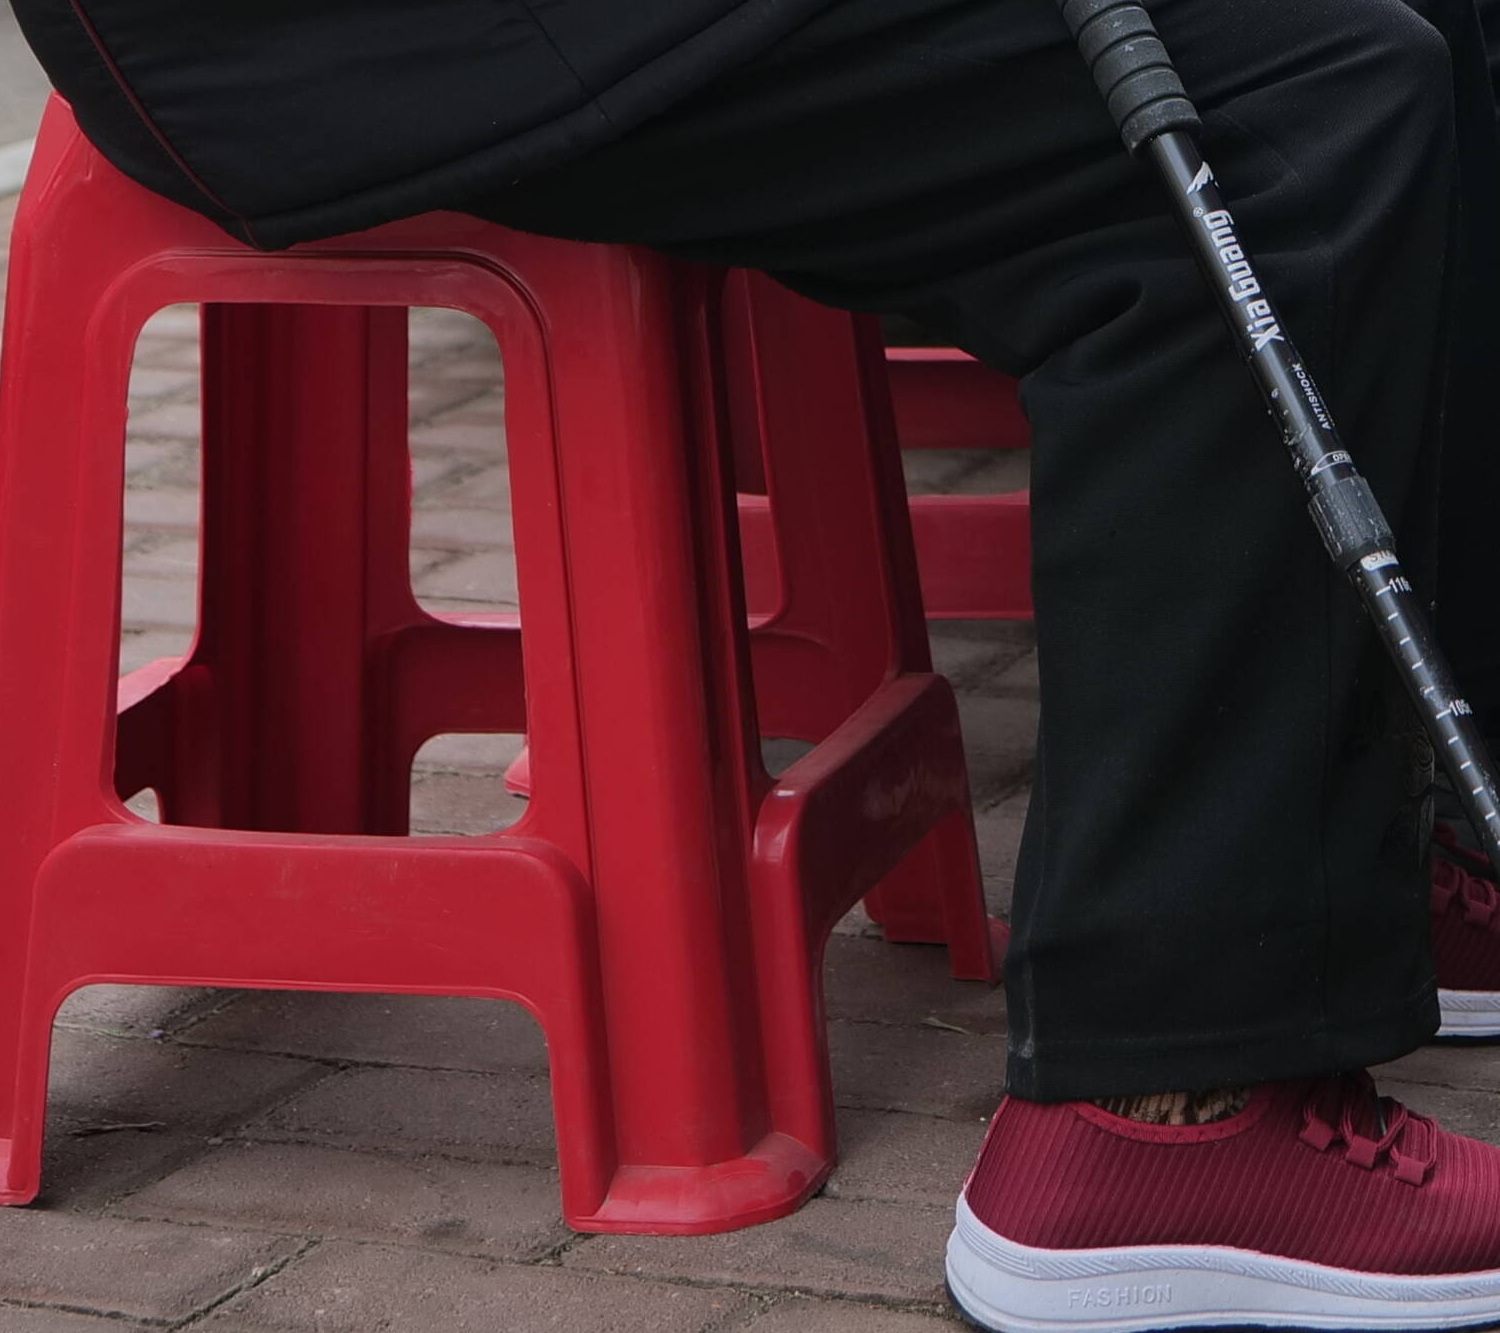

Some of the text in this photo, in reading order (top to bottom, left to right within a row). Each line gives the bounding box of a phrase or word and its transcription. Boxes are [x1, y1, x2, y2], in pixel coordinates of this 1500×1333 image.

[1203, 208, 1285, 352] Xia Guang
[1292, 362, 1332, 430] ANTISHOCK
[1068, 1284, 1173, 1309] FASHION
